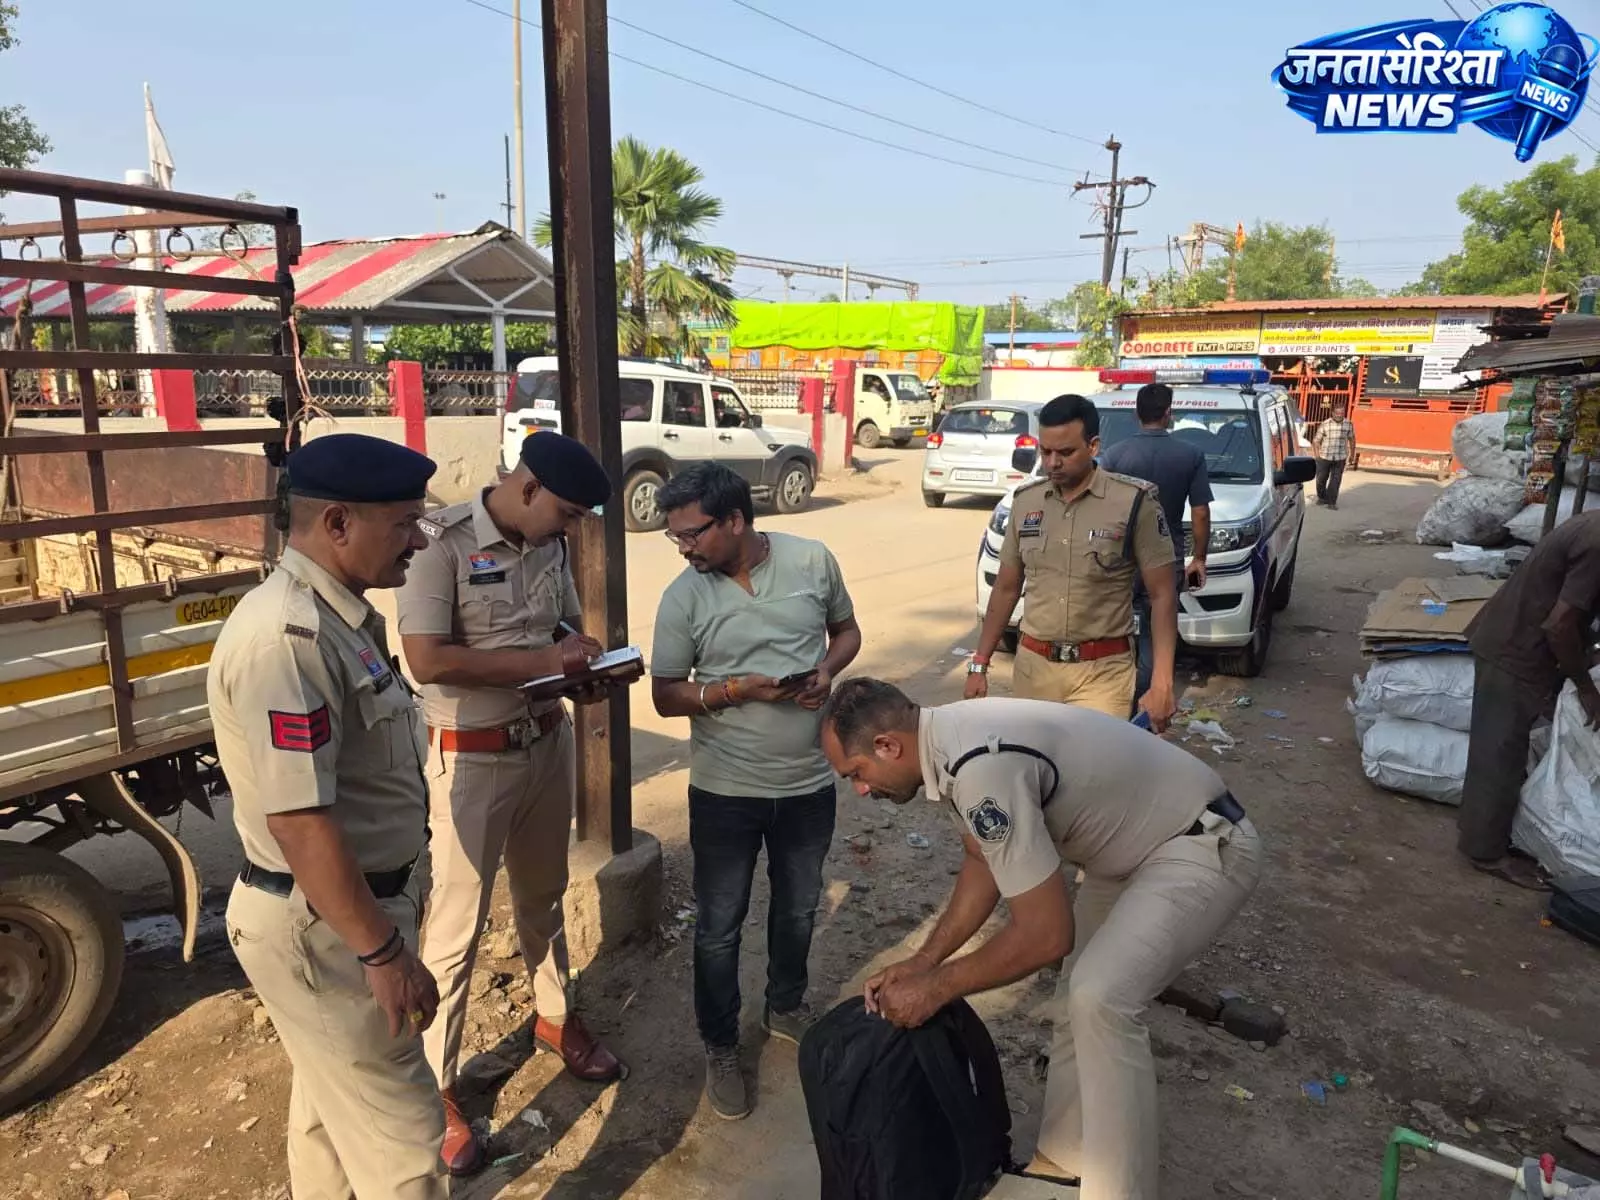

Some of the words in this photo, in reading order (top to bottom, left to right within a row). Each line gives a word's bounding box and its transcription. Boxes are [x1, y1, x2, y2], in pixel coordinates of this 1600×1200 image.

[1123, 342, 1194, 354] CONCRETE
[1197, 343, 1218, 352] TMT
[1226, 342, 1255, 352] PIPES
[1278, 345, 1313, 353] JAYPEE
[1314, 345, 1350, 353] PAINTS
